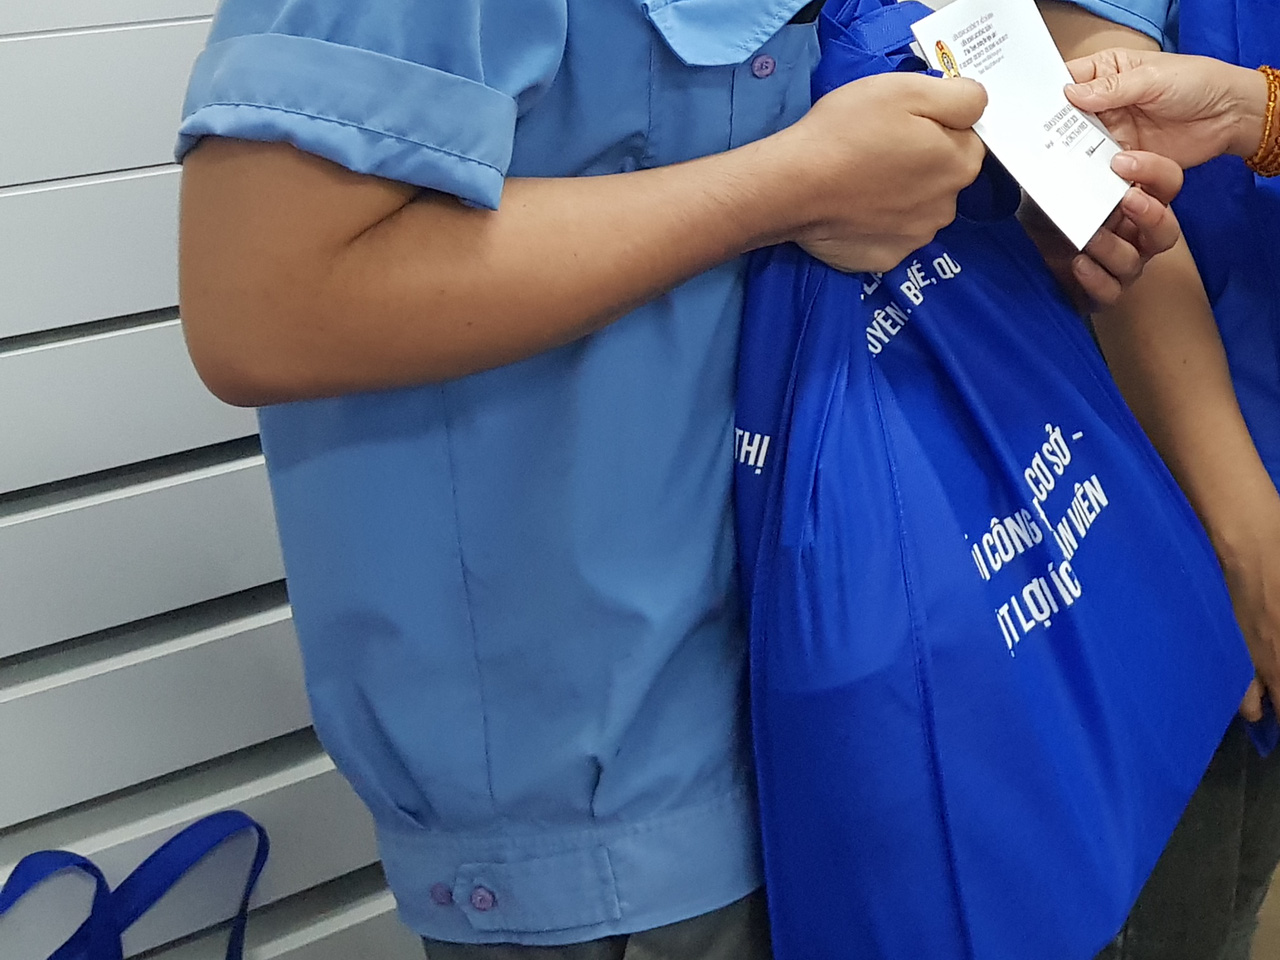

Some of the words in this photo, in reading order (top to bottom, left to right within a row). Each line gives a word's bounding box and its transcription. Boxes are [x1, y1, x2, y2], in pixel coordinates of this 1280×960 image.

[981, 516, 1043, 573] CÔNG
[1024, 451, 1056, 502] CƠ
[1066, 473, 1109, 539] VIÊN
[1010, 576, 1060, 634] LỢI
